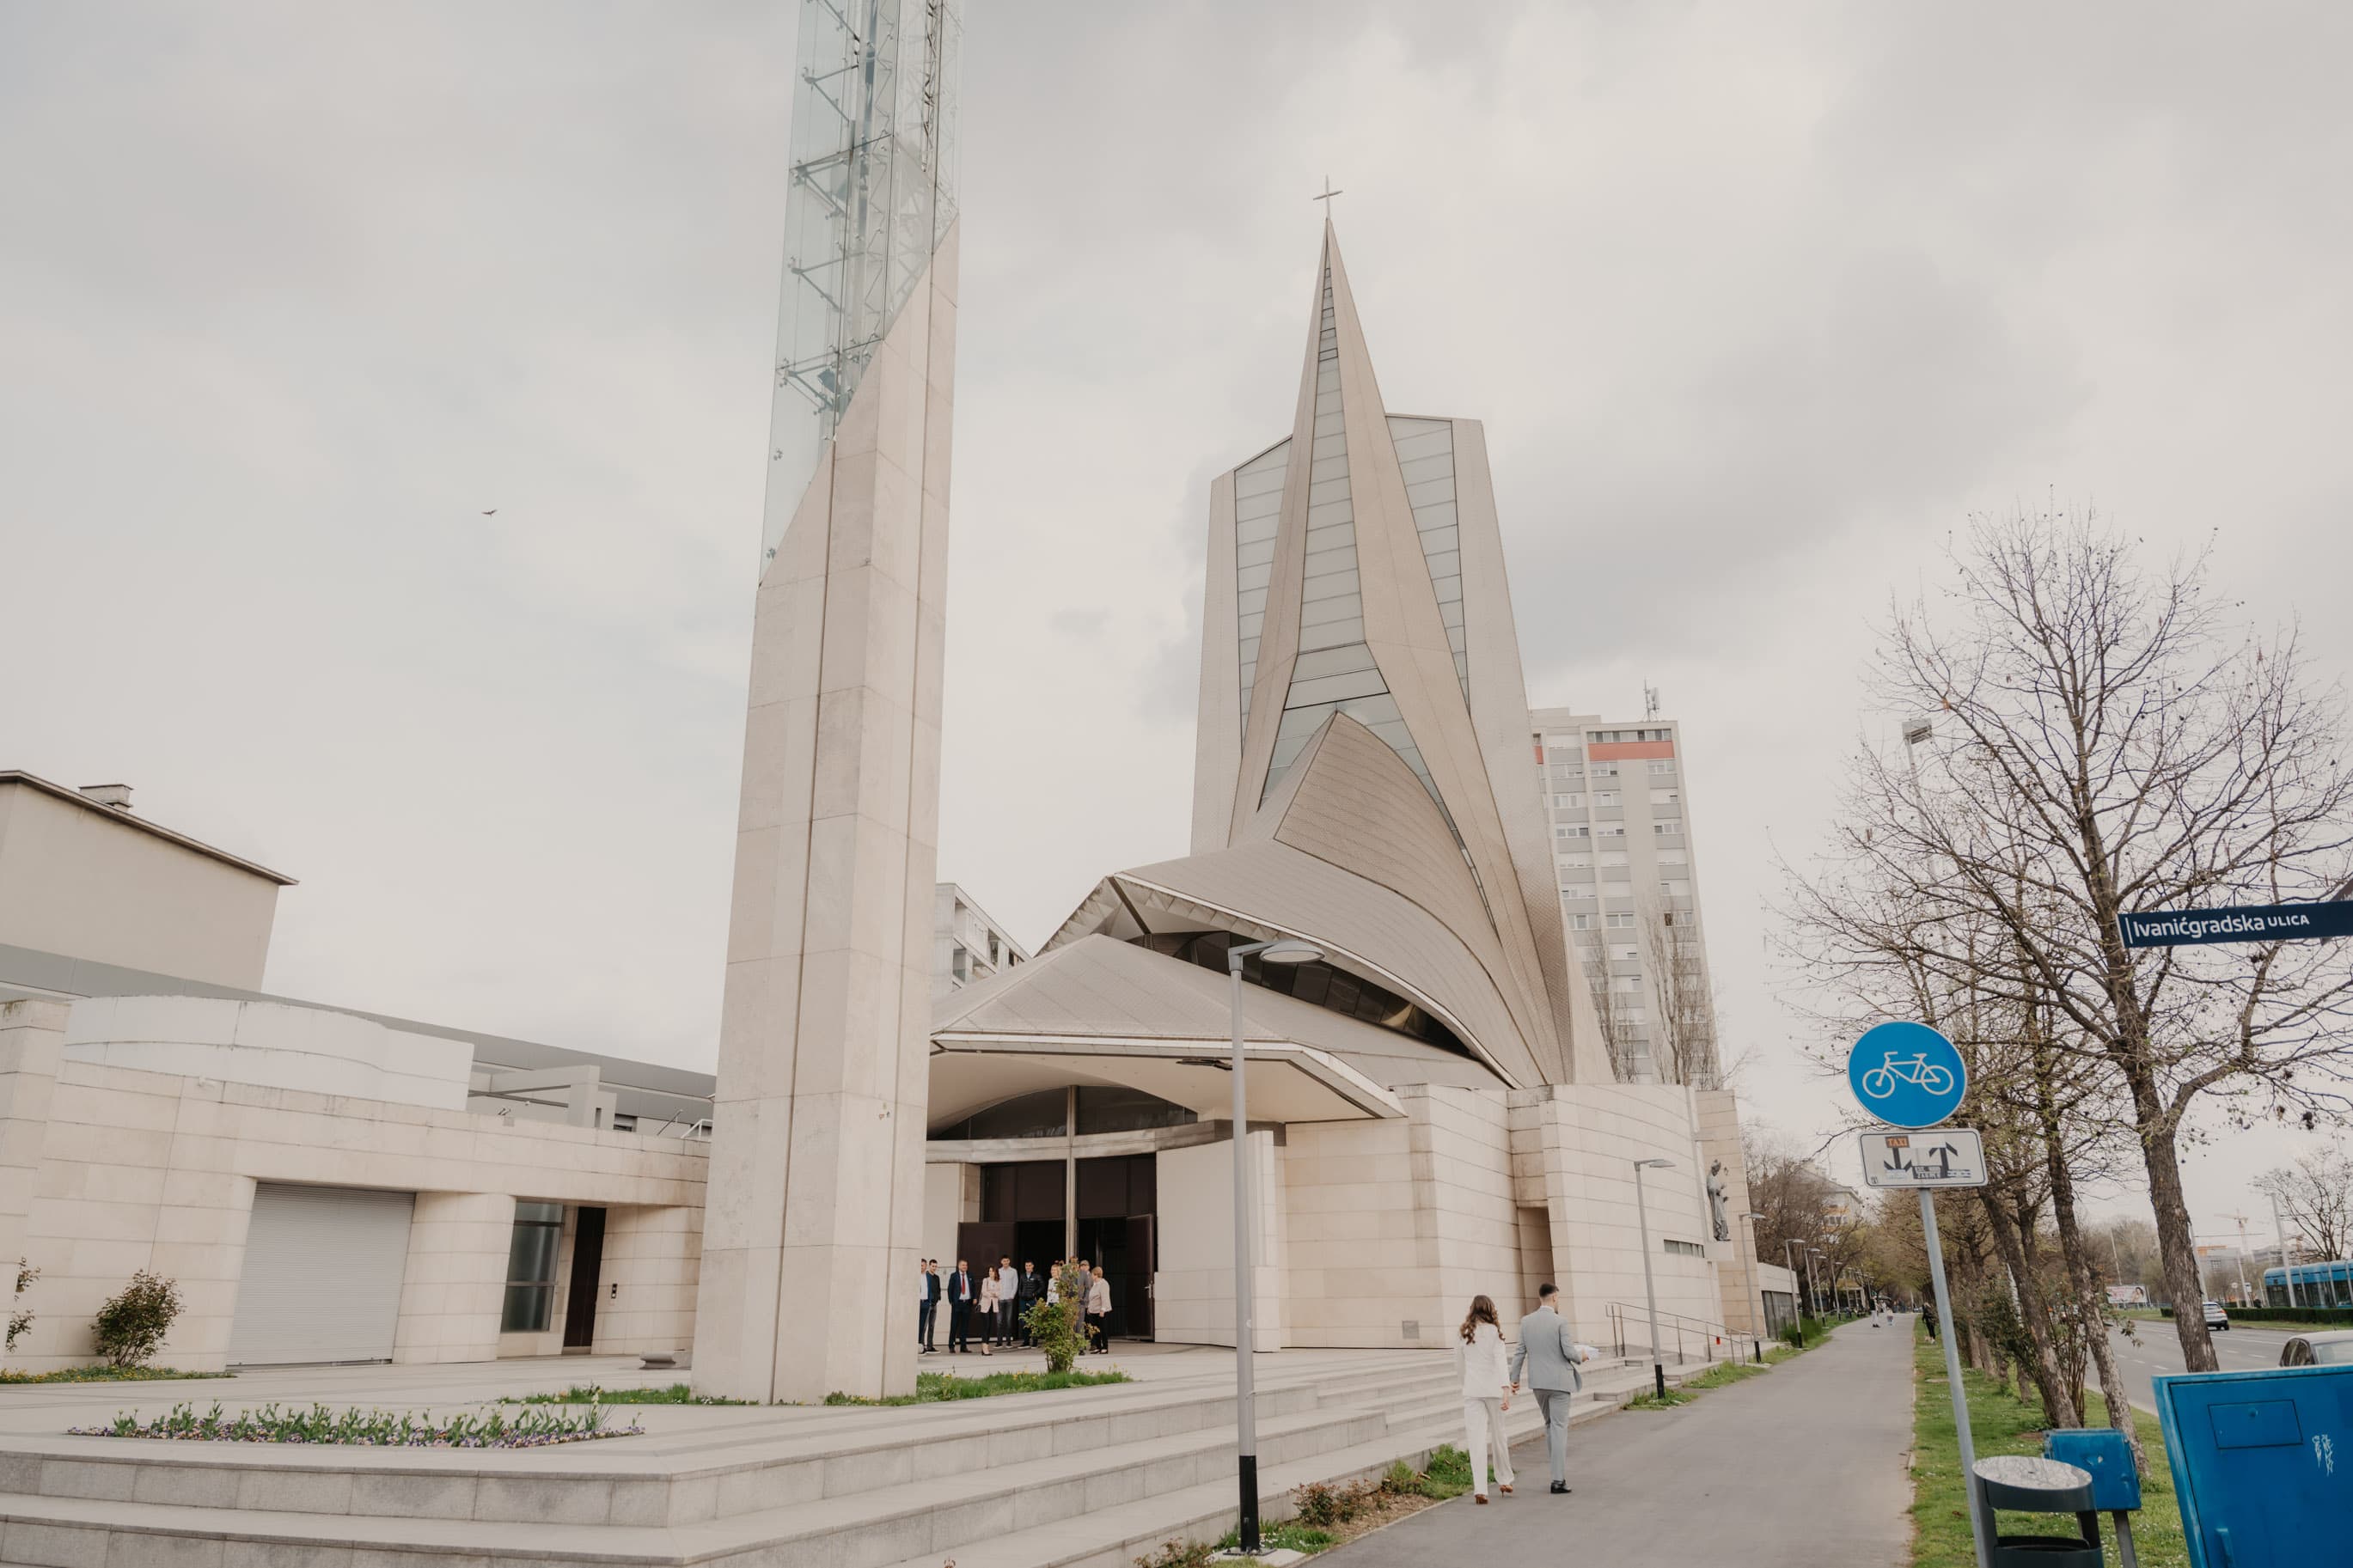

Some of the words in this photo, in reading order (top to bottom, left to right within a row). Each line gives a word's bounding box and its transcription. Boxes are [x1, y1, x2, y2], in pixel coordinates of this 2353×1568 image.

[2133, 914, 2265, 938] Ivanićgradska
[2268, 914, 2310, 927] ULICA
[1888, 1138, 1908, 1147] TAXI
